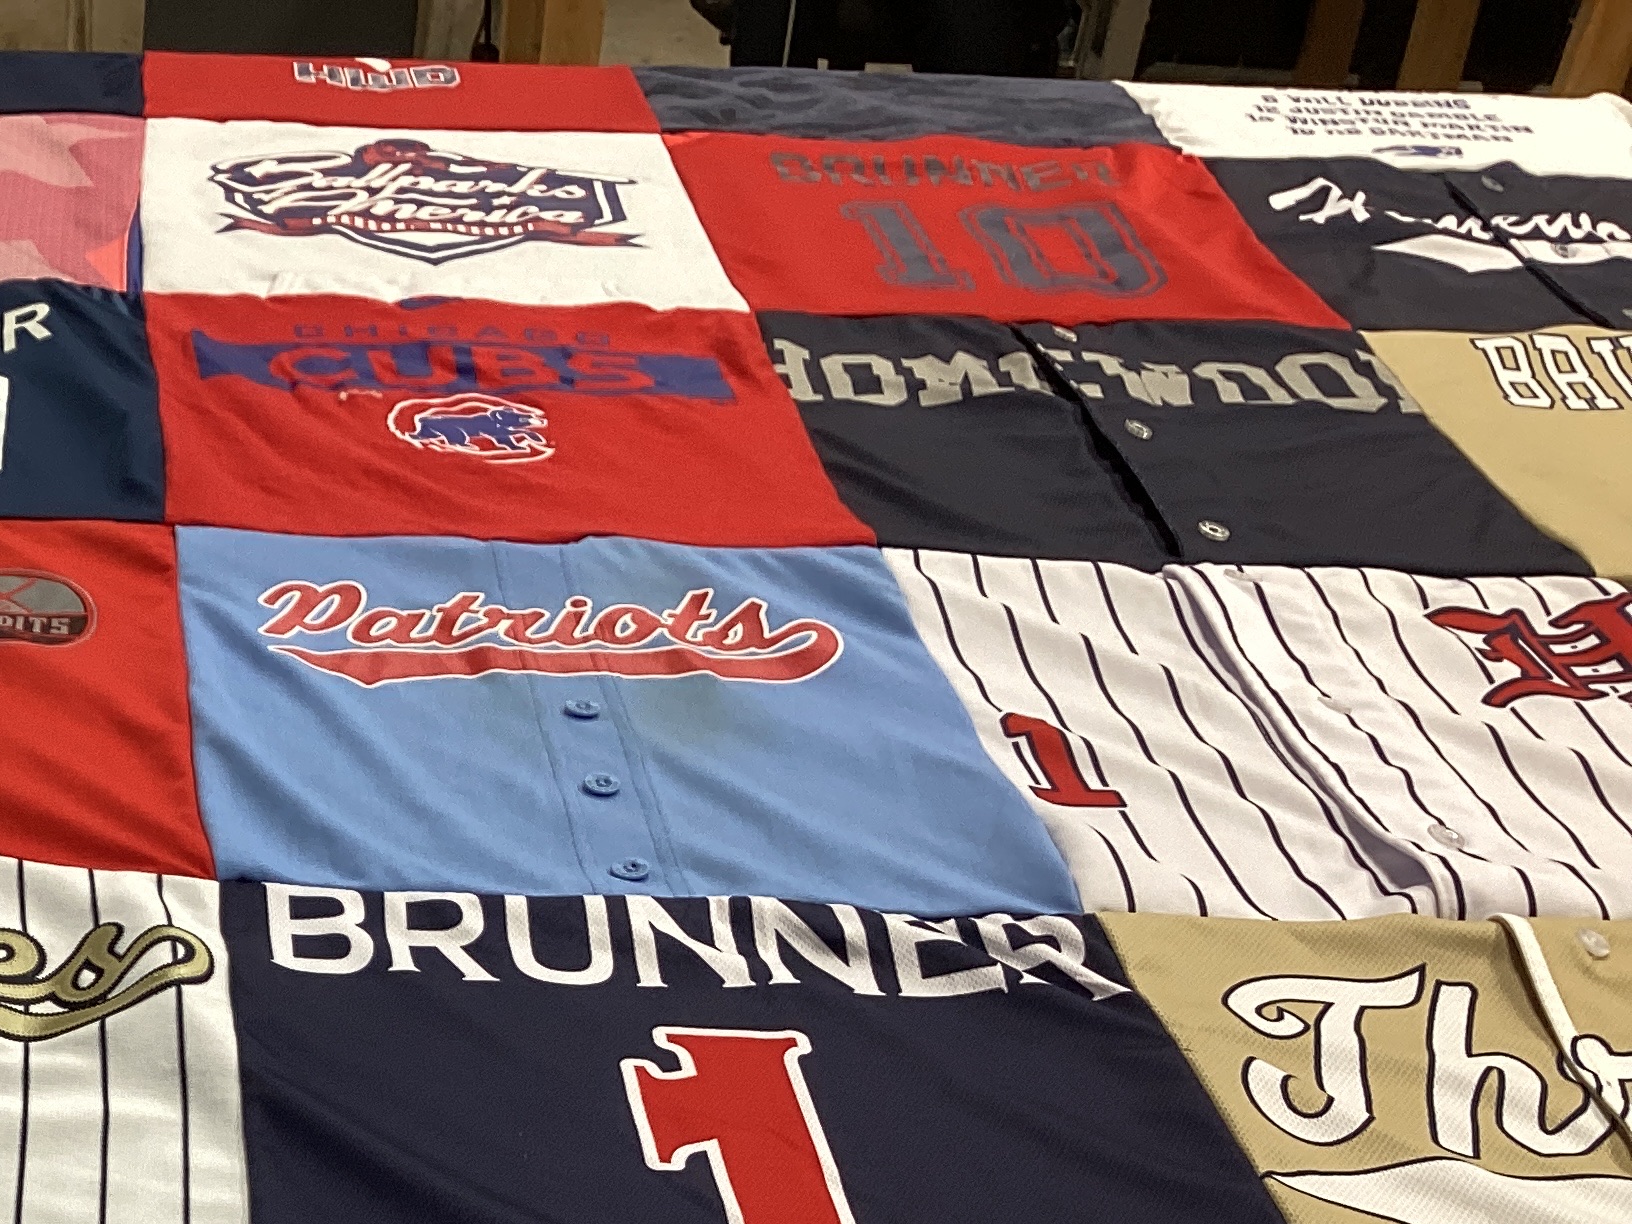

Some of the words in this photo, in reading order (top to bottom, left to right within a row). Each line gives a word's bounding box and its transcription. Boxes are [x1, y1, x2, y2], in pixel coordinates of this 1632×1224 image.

[840, 200, 1167, 297] 10
[268, 345, 656, 390] CUBS
[257, 579, 838, 662] Patriots
[1000, 711, 1128, 808] 1
[263, 881, 1136, 1002] BRUNNER
